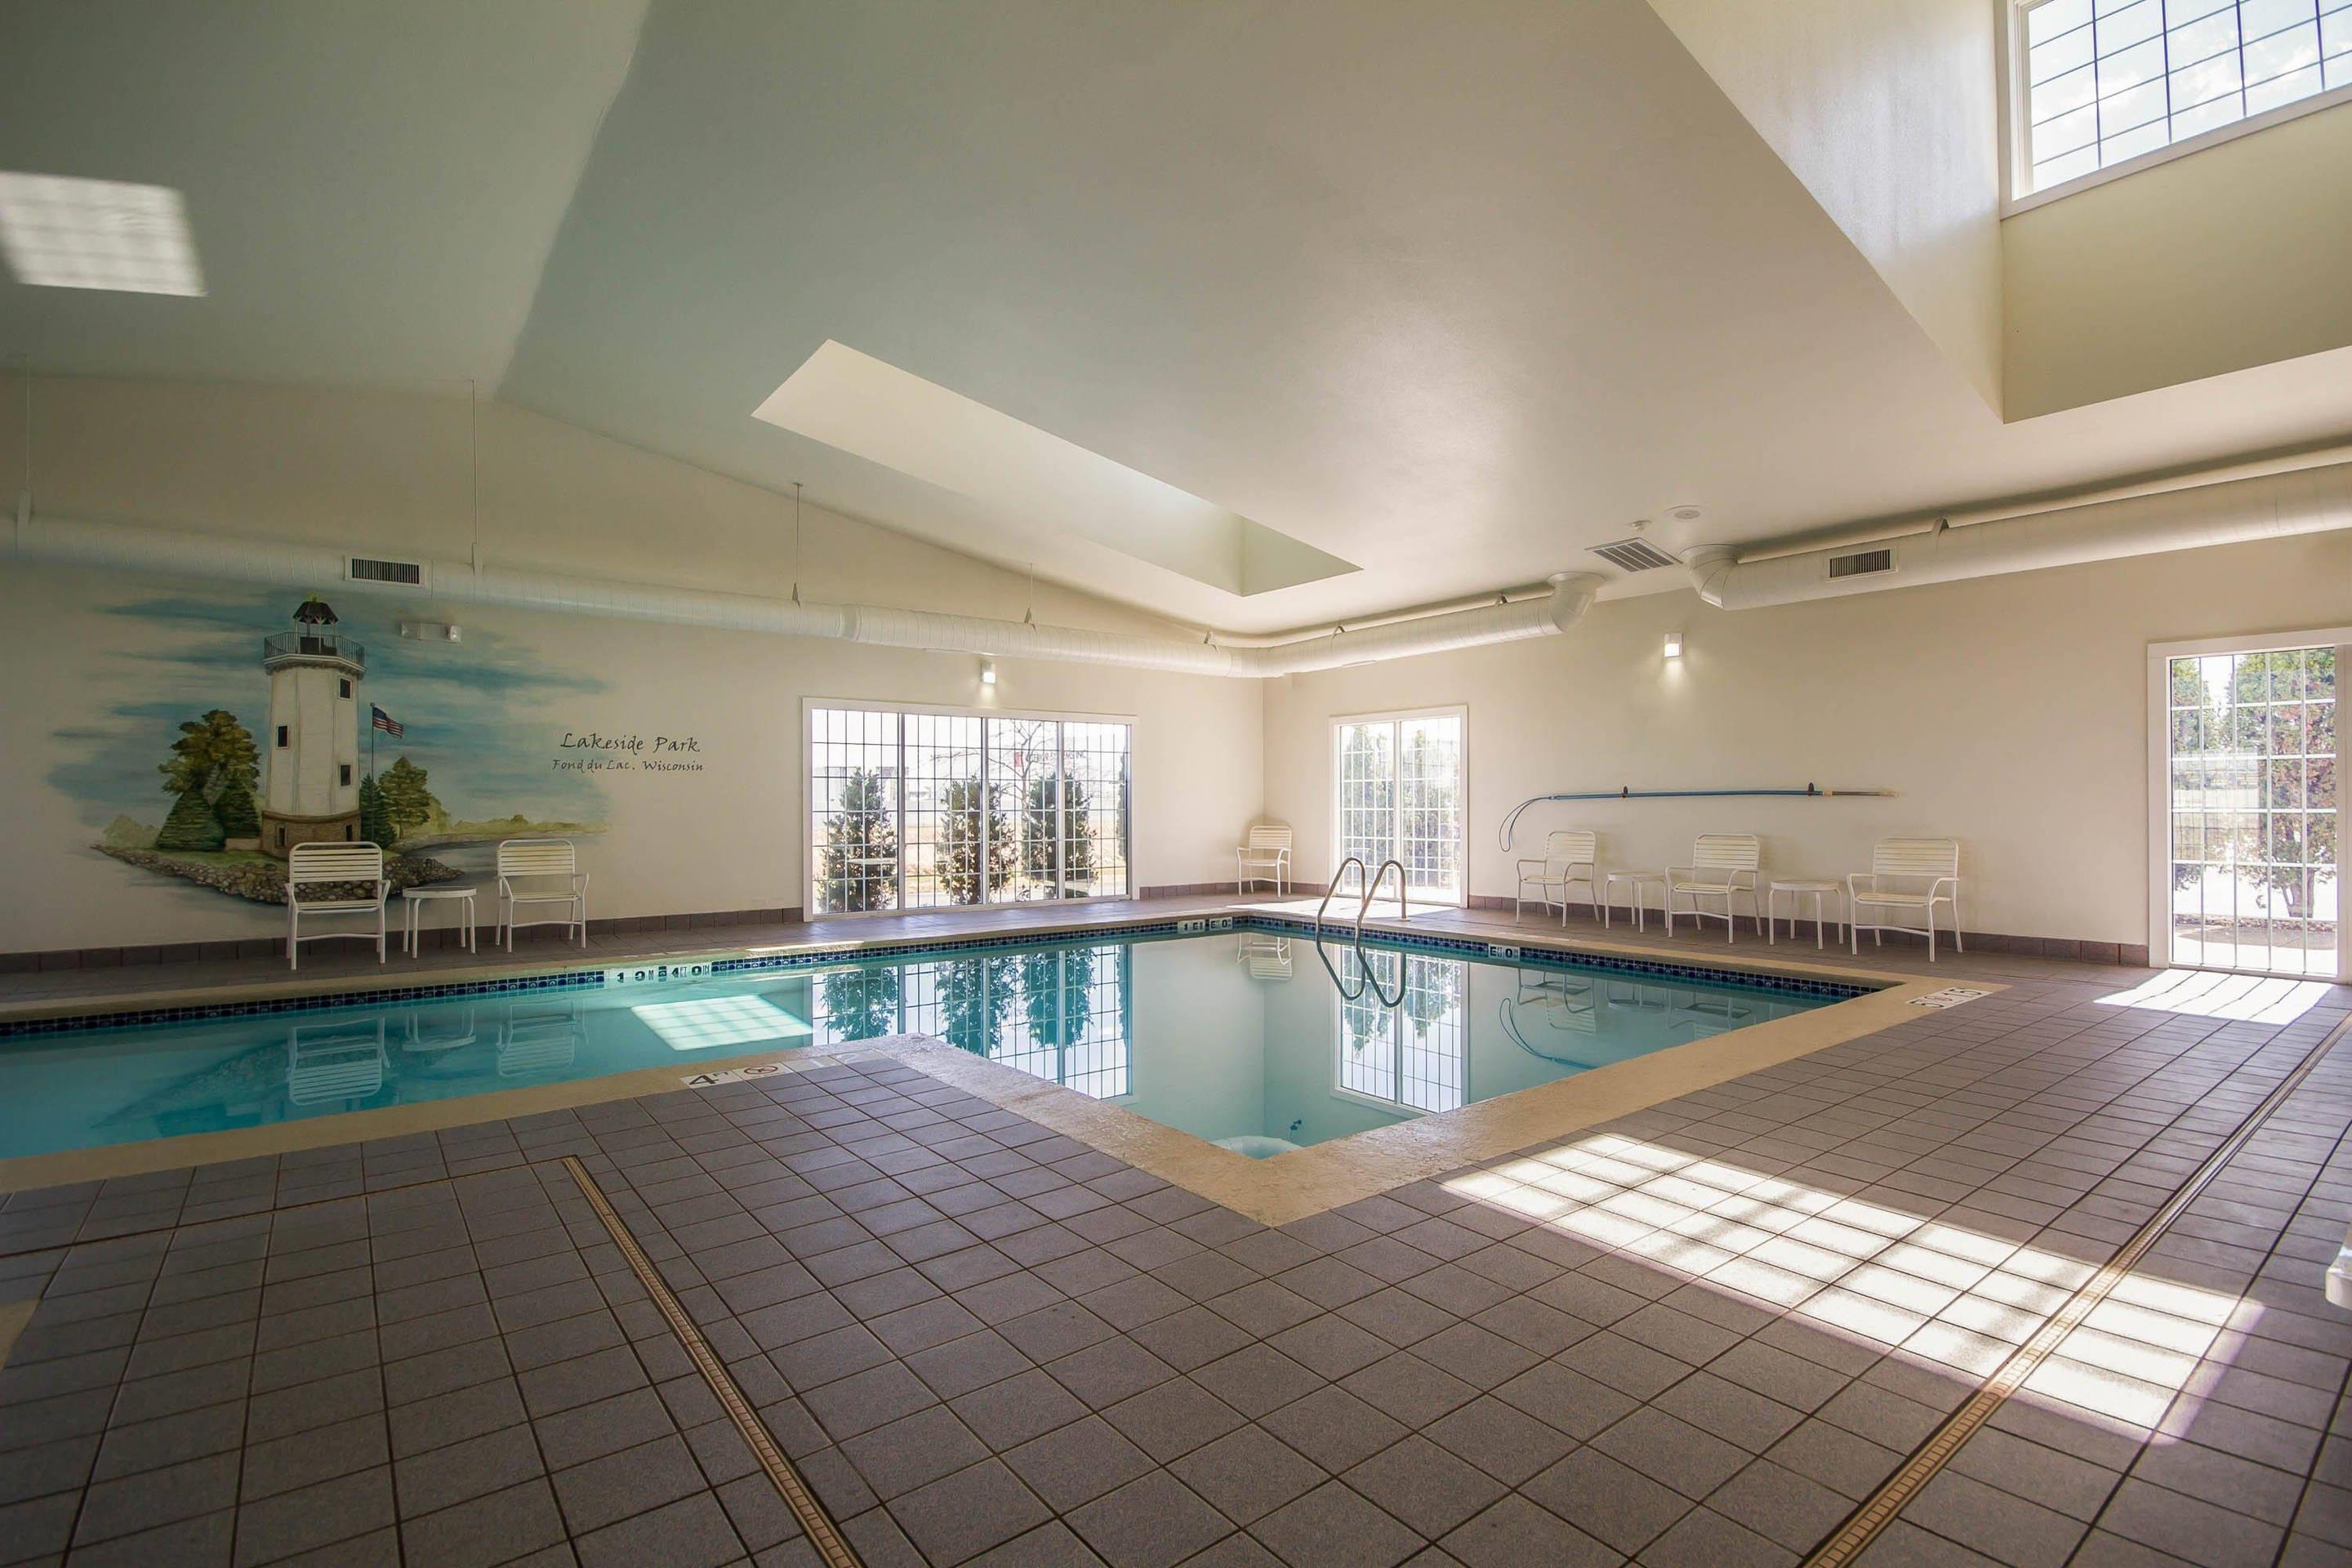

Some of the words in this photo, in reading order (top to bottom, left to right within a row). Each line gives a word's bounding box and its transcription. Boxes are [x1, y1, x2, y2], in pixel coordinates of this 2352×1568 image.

[560, 733, 644, 755] Lakeside
[653, 737, 701, 753] Park
[552, 760, 585, 773] Fond
[586, 761, 602, 773] du
[642, 760, 703, 771] Wisconsin
